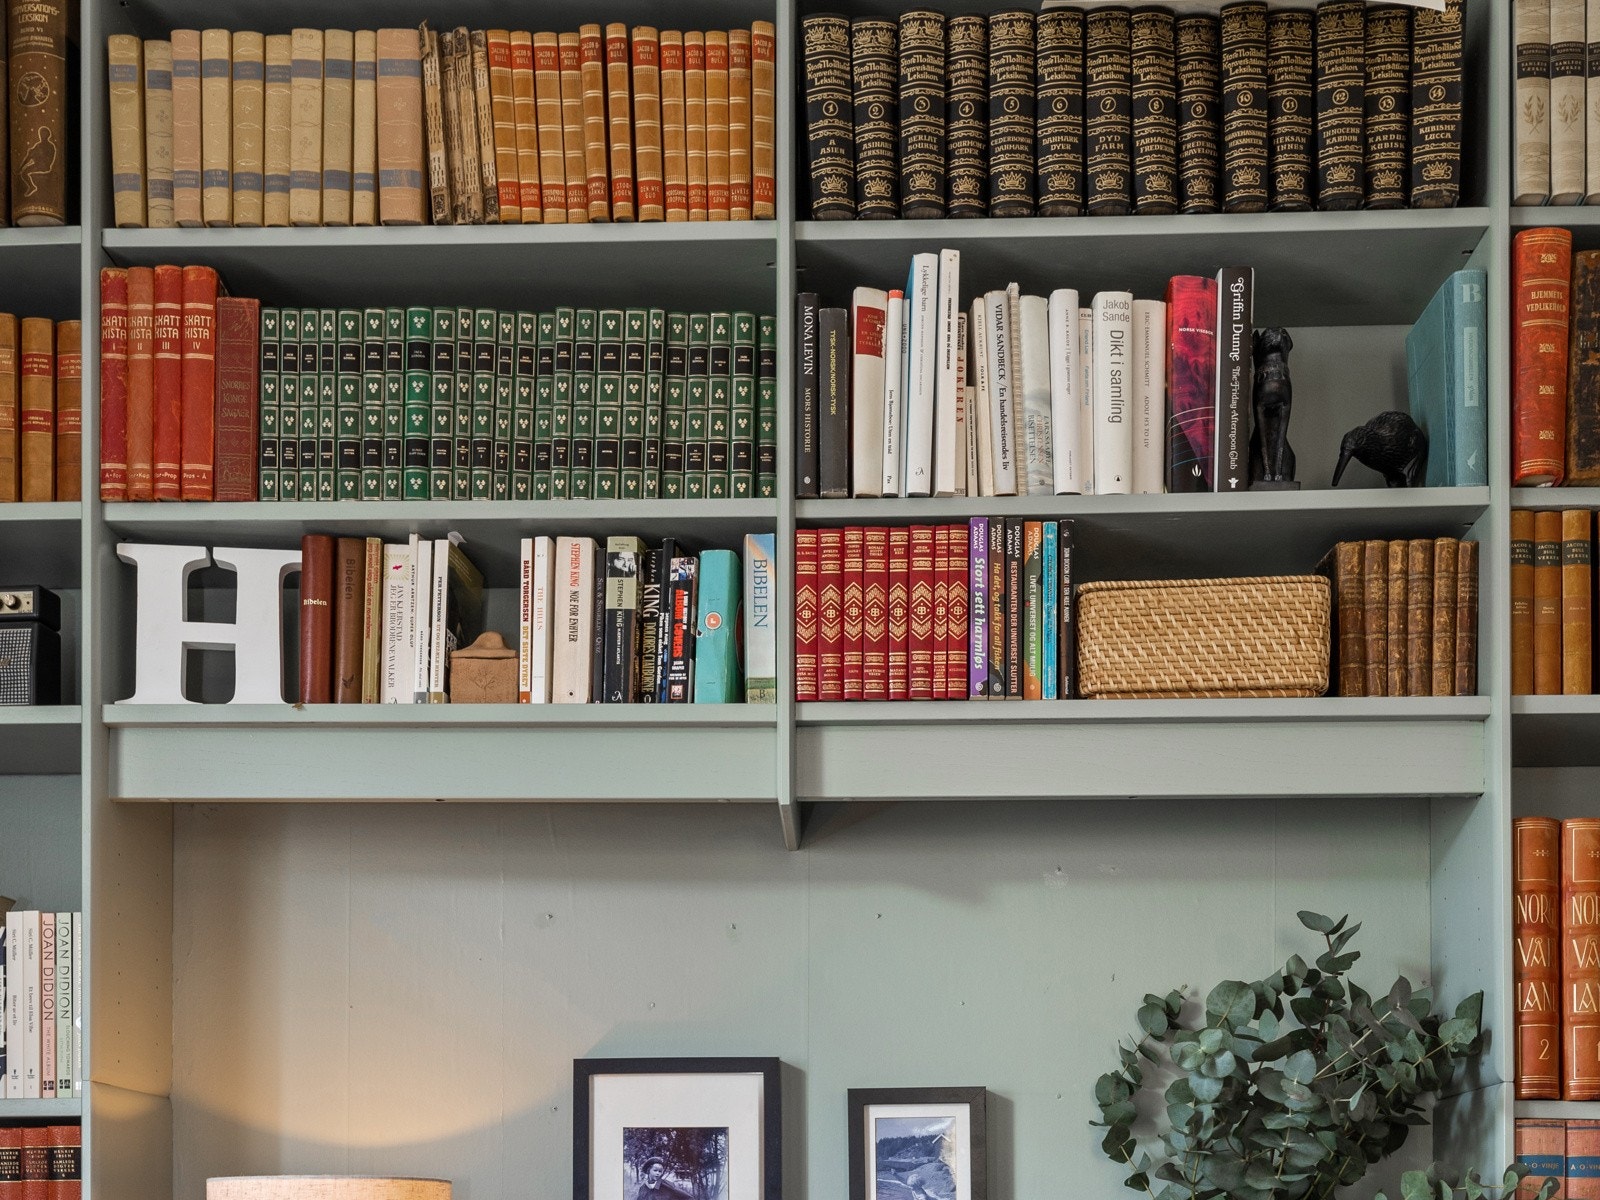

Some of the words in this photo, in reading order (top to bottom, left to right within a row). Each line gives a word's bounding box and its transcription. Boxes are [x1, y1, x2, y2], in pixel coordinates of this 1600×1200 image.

[1095, 142, 1124, 152] FARM
[1424, 132, 1452, 142] LUCCA
[954, 148, 979, 156] CEDER
[920, 265, 929, 296] Lykkelige
[1102, 299, 1130, 310] Jakob
[1230, 277, 1245, 321] Griffin
[1462, 284, 1482, 303] B
[1531, 290, 1564, 300] HJEMMETS
[1102, 312, 1130, 322] Sande
[1526, 301, 1566, 313] VEDLIKEHOLD
[184, 316, 211, 327] SKATT
[804, 305, 813, 339] MONA
[1196, 328, 1214, 336] VISEBOK
[102, 328, 126, 340] KISTA
[154, 328, 179, 339] KISTA
[184, 328, 210, 340] KISTA
[1110, 330, 1124, 357] Dikt
[1230, 323, 1244, 362] Dunne
[162, 342, 170, 350] III
[192, 342, 200, 350] IV
[996, 334, 1006, 380] SANDBECK
[804, 342, 813, 375] LEVIN
[1232, 366, 1240, 381] The
[956, 356, 964, 424] JOKEREN
[1108, 369, 1124, 424] samling
[1230, 381, 1240, 409] Friday
[1000, 399, 1008, 460] handelsreisendes
[1144, 428, 1149, 437] TO
[1228, 410, 1239, 450] Afternoon
[1229, 450, 1238, 470] Club
[570, 543, 580, 570] STEPHEN
[994, 562, 1001, 574] Ha
[346, 558, 356, 600] Bibelen
[570, 571, 580, 587] KING
[974, 558, 985, 588] Stort
[303, 598, 328, 606] Bibelen
[570, 590, 580, 603] NOE
[642, 584, 660, 618] KING
[675, 589, 684, 620] ALBUM
[753, 558, 768, 628] BIBELEN
[974, 591, 985, 614] sett
[993, 593, 1000, 601] og
[569, 604, 579, 617] FOR
[568, 618, 579, 642] ENHVER
[642, 622, 656, 654] DOLORES
[673, 622, 684, 658] COVERS
[1030, 632, 1036, 642] OG
[973, 618, 985, 670] harmløs
[43, 920, 54, 960] JOAN
[59, 919, 69, 959] JOAN
[44, 967, 54, 1020] DIDION
[59, 966, 70, 1019] DIDION
[1538, 1038, 1550, 1060] 2
